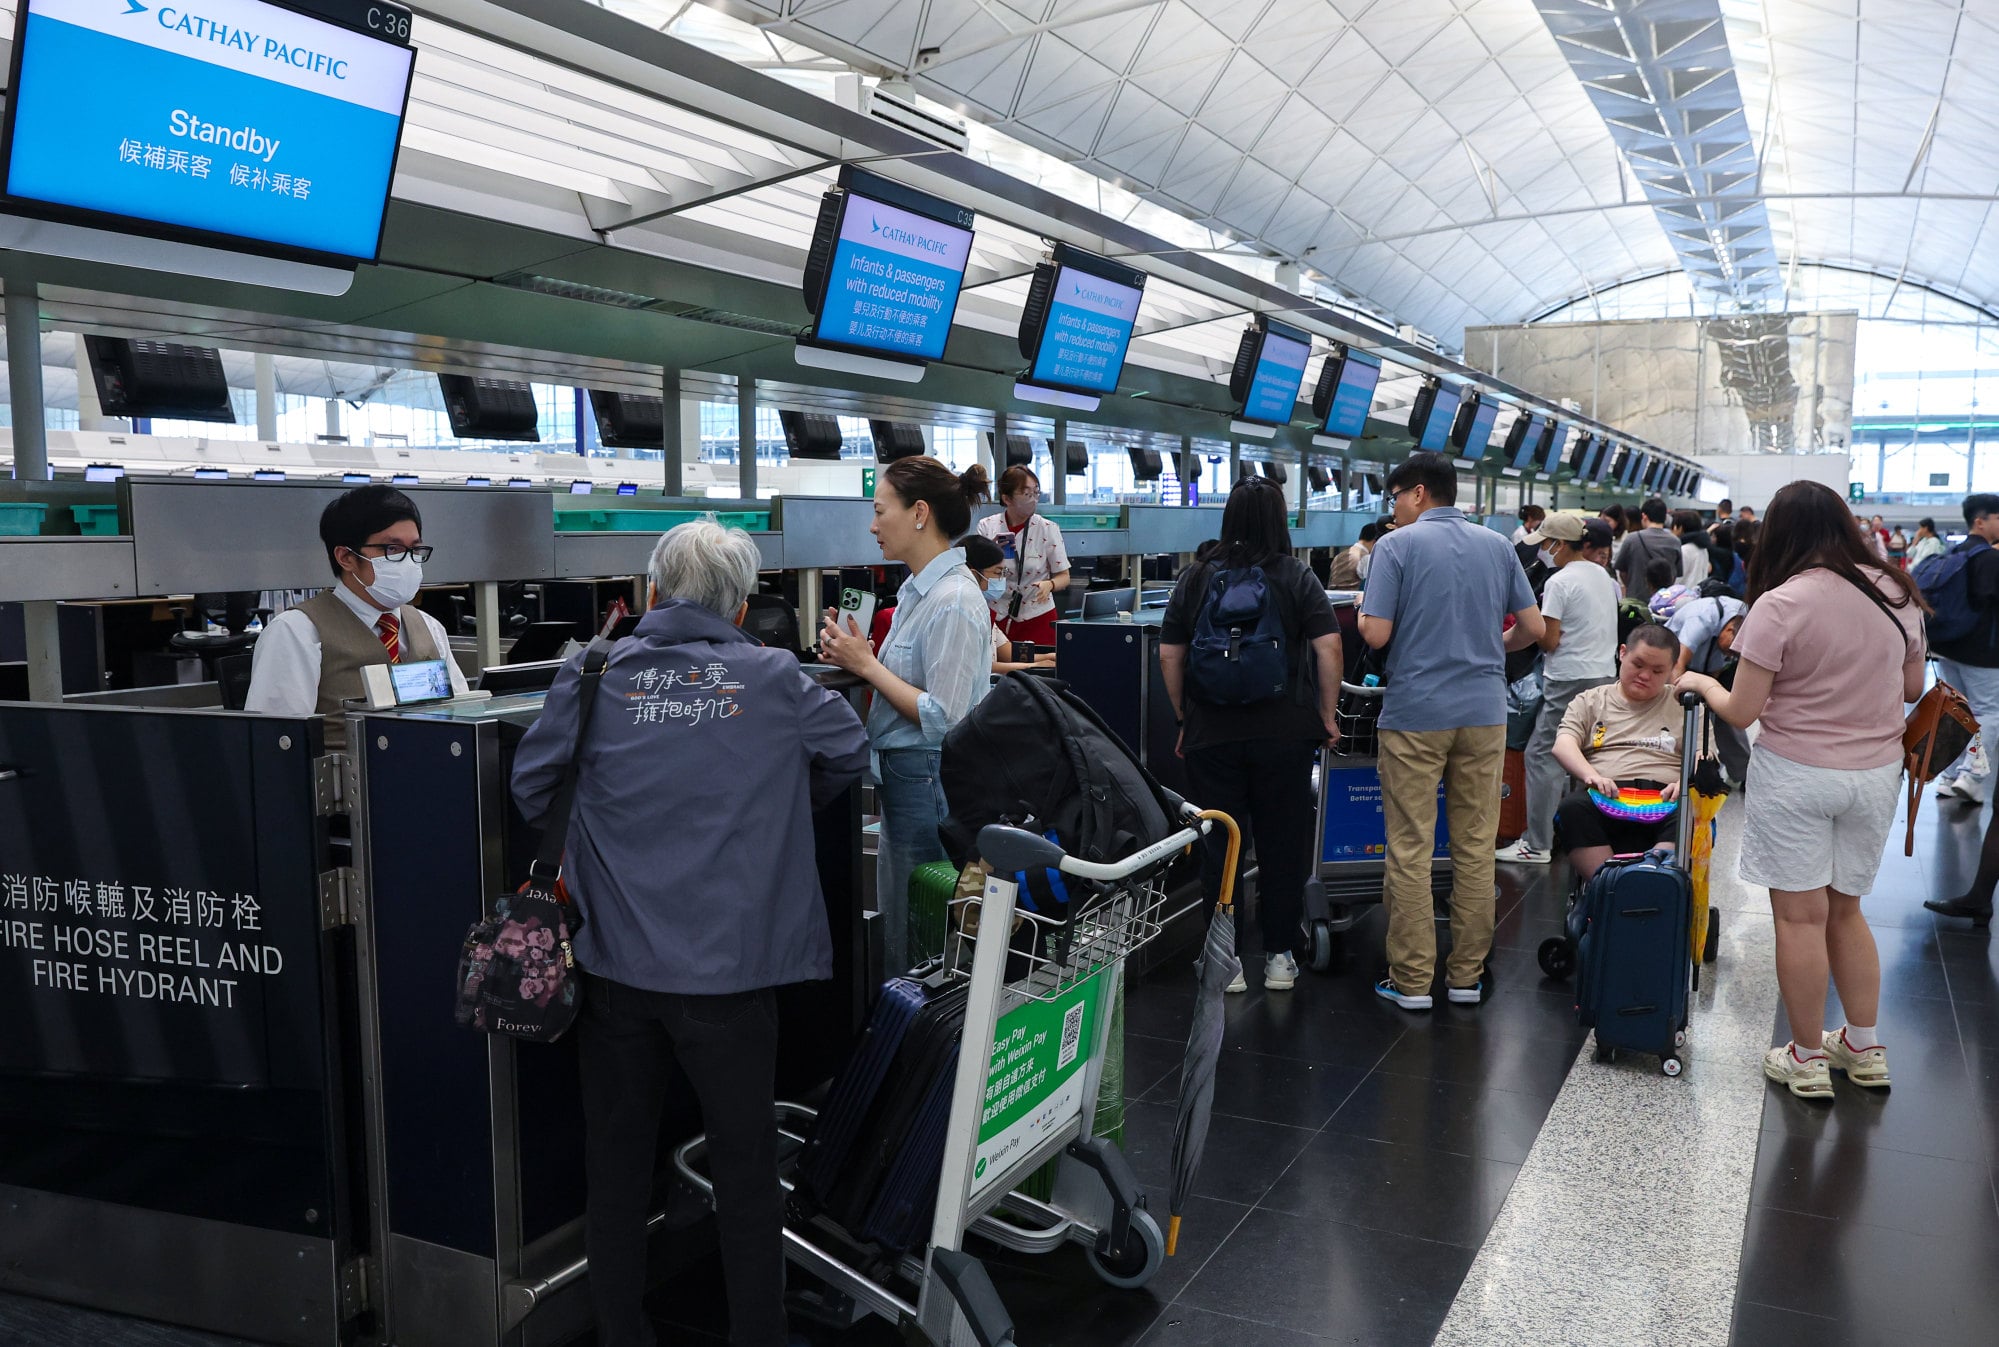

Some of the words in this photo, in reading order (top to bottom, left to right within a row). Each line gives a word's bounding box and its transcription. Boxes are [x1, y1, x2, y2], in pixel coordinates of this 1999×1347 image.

[157, 7, 260, 53] CATHAY
[263, 38, 349, 81] PACIFIC
[168, 109, 281, 162] Standby
[118, 137, 213, 180] 候補乘客
[229, 162, 313, 201] 候补乘客
[882, 226, 916, 246] CATHAY
[917, 236, 948, 255] PACIFIC
[850, 253, 885, 277] Infants
[885, 263, 893, 279] &
[894, 268, 946, 292] passengers
[846, 277, 867, 294] with
[868, 283, 908, 303] reduced
[908, 292, 943, 314] mobility
[1082, 289, 1103, 304] CATHAY
[1054, 330, 1068, 343] with
[1069, 333, 1095, 349] reduced
[1095, 339, 1118, 356] mobility
[1058, 313, 1081, 328] Infants
[1087, 321, 1121, 339] passengers
[2, 873, 262, 931] 消防喉轆及消防栓
[526, 889, 558, 904] ever
[0, 919, 45, 950] IRE
[54, 925, 130, 960] HOSE
[139, 933, 210, 968] REEL
[217, 942, 283, 975] AND
[33, 959, 89, 992] FIRE
[98, 966, 238, 1008] HYDRANT
[988, 1056, 1005, 1077] with
[1007, 1040, 1032, 1065] Weixin
[1033, 1030, 1047, 1048] Pay
[991, 1036, 1011, 1056] Easy
[1012, 1025, 1026, 1043] Pay
[989, 1145, 1009, 1166] Weixin
[1009, 1135, 1020, 1150] Pay
